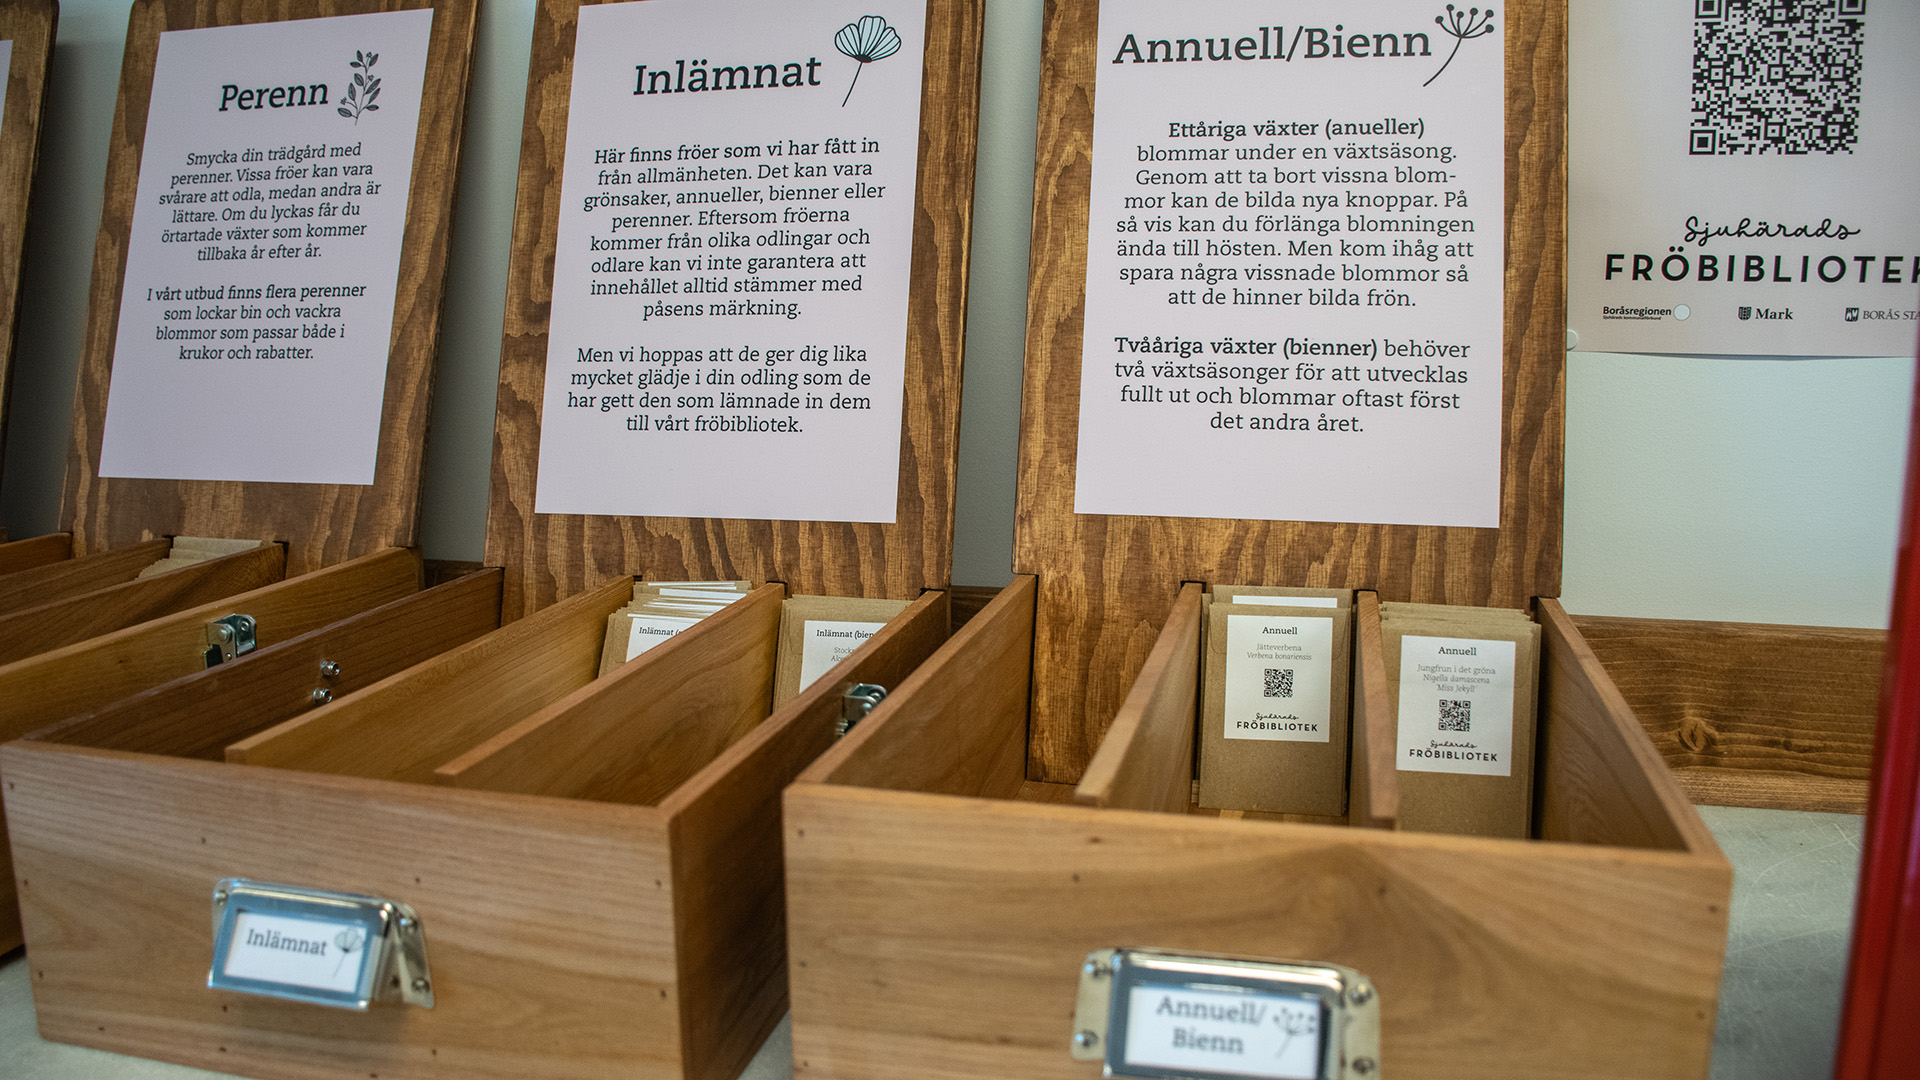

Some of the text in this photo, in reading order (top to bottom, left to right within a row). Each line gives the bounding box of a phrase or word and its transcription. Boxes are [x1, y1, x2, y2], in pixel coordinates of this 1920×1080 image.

[1112, 24, 1432, 64] Annuell/Bienn
[633, 57, 822, 96] Inlämnat
[218, 83, 328, 112] Perenn
[1168, 117, 1424, 142] Ettåriga växter (anueller)
[186, 142, 362, 168] Smycka din trädgård med
[594, 137, 880, 164] Här finns fröer som vi har fått in
[1137, 142, 1457, 164] blommar under en växtsäsong.
[170, 164, 373, 189] perenner. Vissa fröer kan vara
[598, 162, 872, 186] från allmänheten. Det kan vara
[1136, 166, 1456, 185] Genom att ta bort vissna blom-
[172, 201, 360, 223] lättare. Om du lyckas får du
[611, 207, 850, 233] perenner. Eftersom fröerna
[1116, 214, 1475, 237] så vis kan du förlänga blomningen
[1684, 216, 1861, 247] Sjuhärads
[198, 243, 321, 261] tillbaka år efter år.
[590, 274, 862, 295] innehållet alltid stämmer med
[1119, 262, 1469, 285] spara några vissnade blommor så
[147, 284, 367, 302] I vårt utbud finns flera perenner
[1168, 287, 1416, 306] att de hinner bilda frön.
[164, 303, 341, 320] som lockar bin och vackra
[643, 299, 801, 321] påsens märkning.
[1603, 306, 1672, 317] Boråsregionen
[1755, 308, 1794, 320] Mark
[1862, 309, 1900, 320] BORÅS
[179, 344, 313, 360] krukor och rabatter.
[577, 345, 867, 367] Men vi hoppas att de ger dig lika
[1114, 336, 1471, 362] Tvååriga växter (bienner) behöver
[571, 368, 871, 390] mycket glädje i din odling som de
[1115, 360, 1468, 385] två växtsäsonger för att utvecklas
[626, 414, 803, 433] till vårt fröbibliotek.
[1210, 411, 1363, 432] det andra året.
[639, 627, 674, 636] Inlämnat
[816, 629, 853, 638] Inlämnat
[1262, 627, 1298, 635] Annuell
[1247, 652, 1312, 660] Verbena bonariensis
[1438, 646, 1477, 656] Annuell
[1417, 664, 1452, 674] Jungfrun
[1458, 665, 1472, 674] det
[1423, 674, 1490, 684] Nigella damascena
[1236, 720, 1318, 732] FRÖBIBLIOTEK
[1409, 748, 1498, 762] FRÖBIBLIOTEK
[246, 929, 327, 956] Inlämnat
[1156, 996, 1267, 1026] Annuell/
[1172, 1026, 1244, 1054] Bienn
